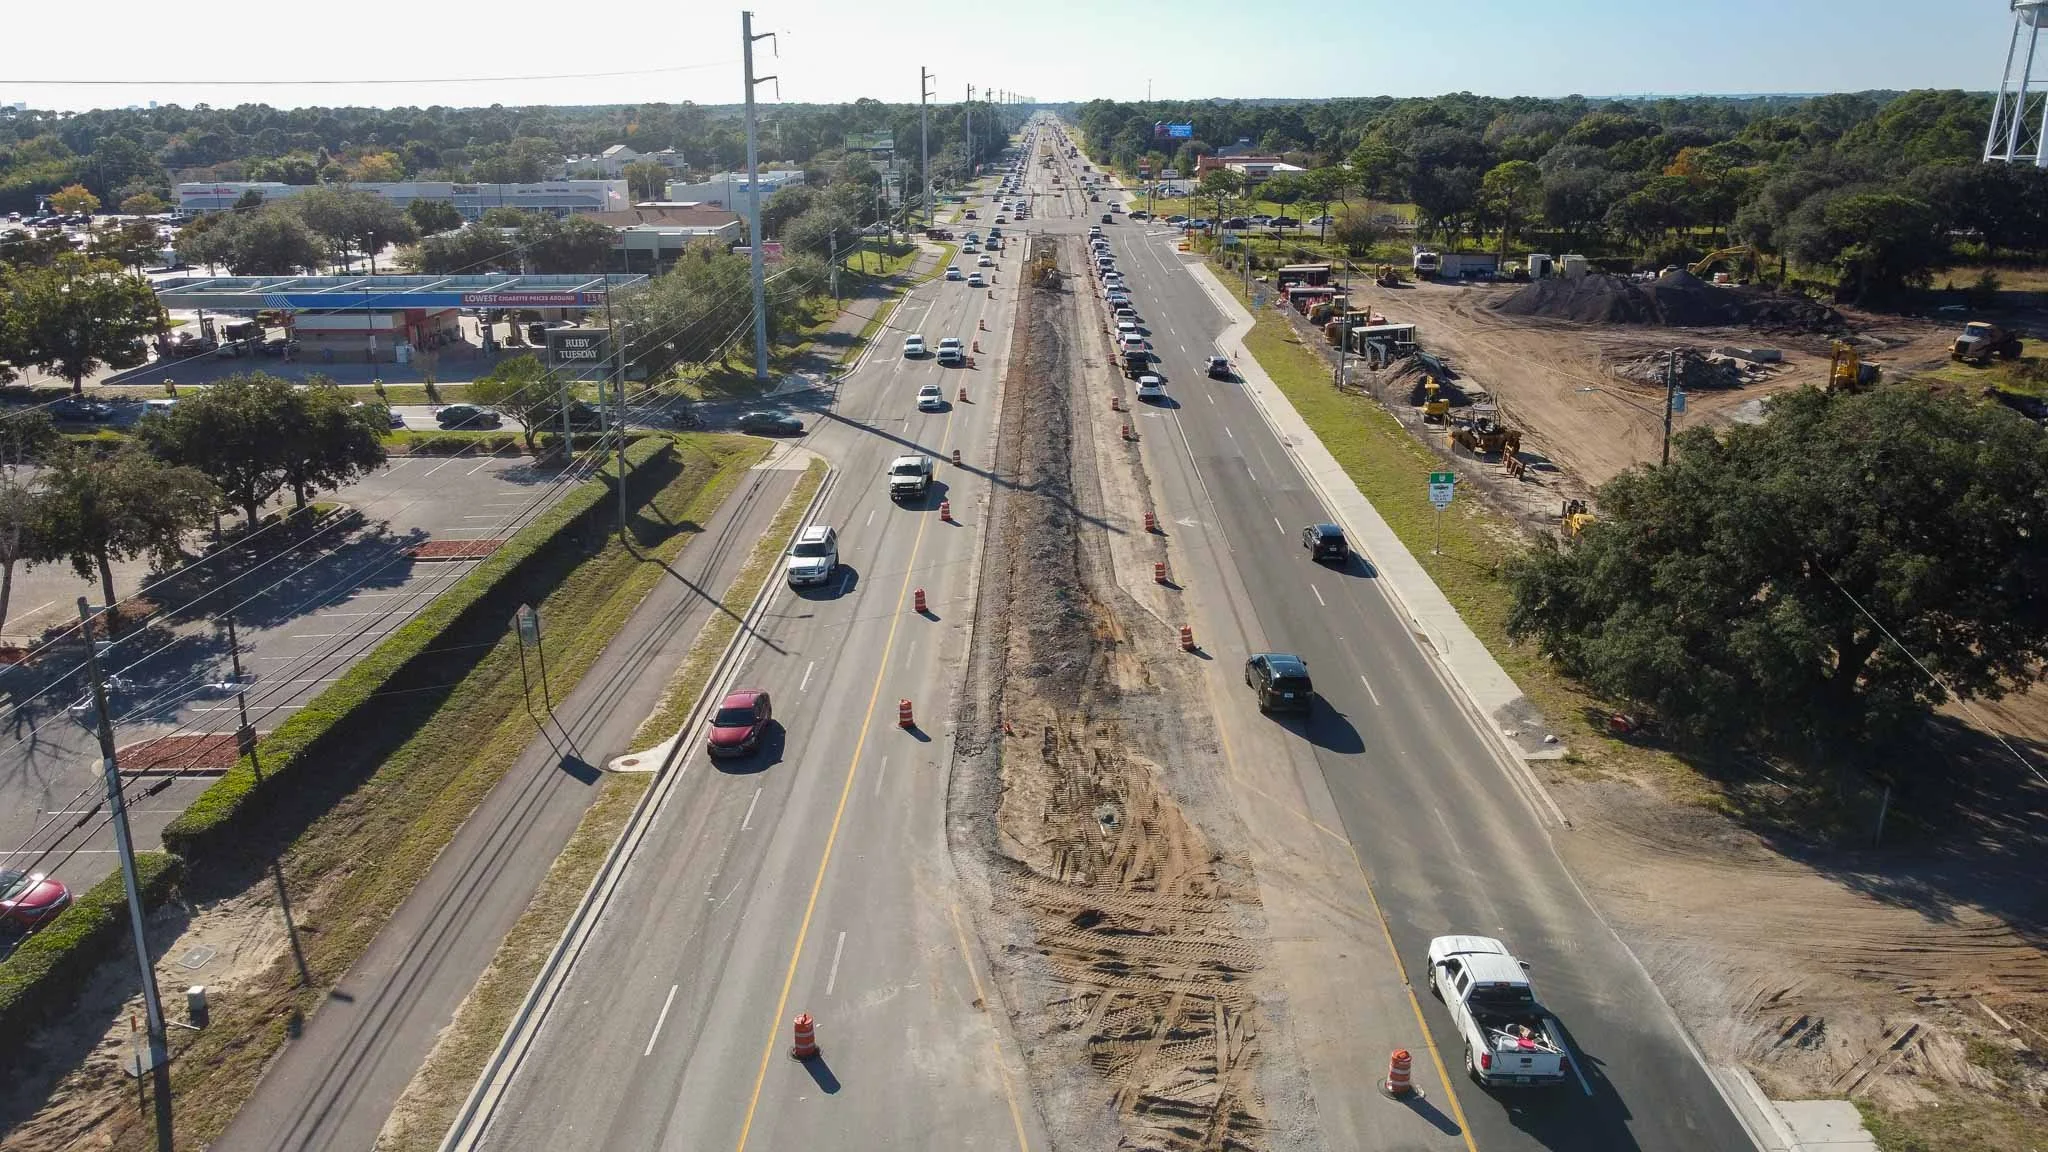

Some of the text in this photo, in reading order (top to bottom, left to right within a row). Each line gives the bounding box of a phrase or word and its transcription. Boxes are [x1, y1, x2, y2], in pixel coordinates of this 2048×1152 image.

[464, 294, 497, 302] LOWEST
[565, 338, 590, 348] RUBY
[560, 350, 598, 359] TUESDAY
